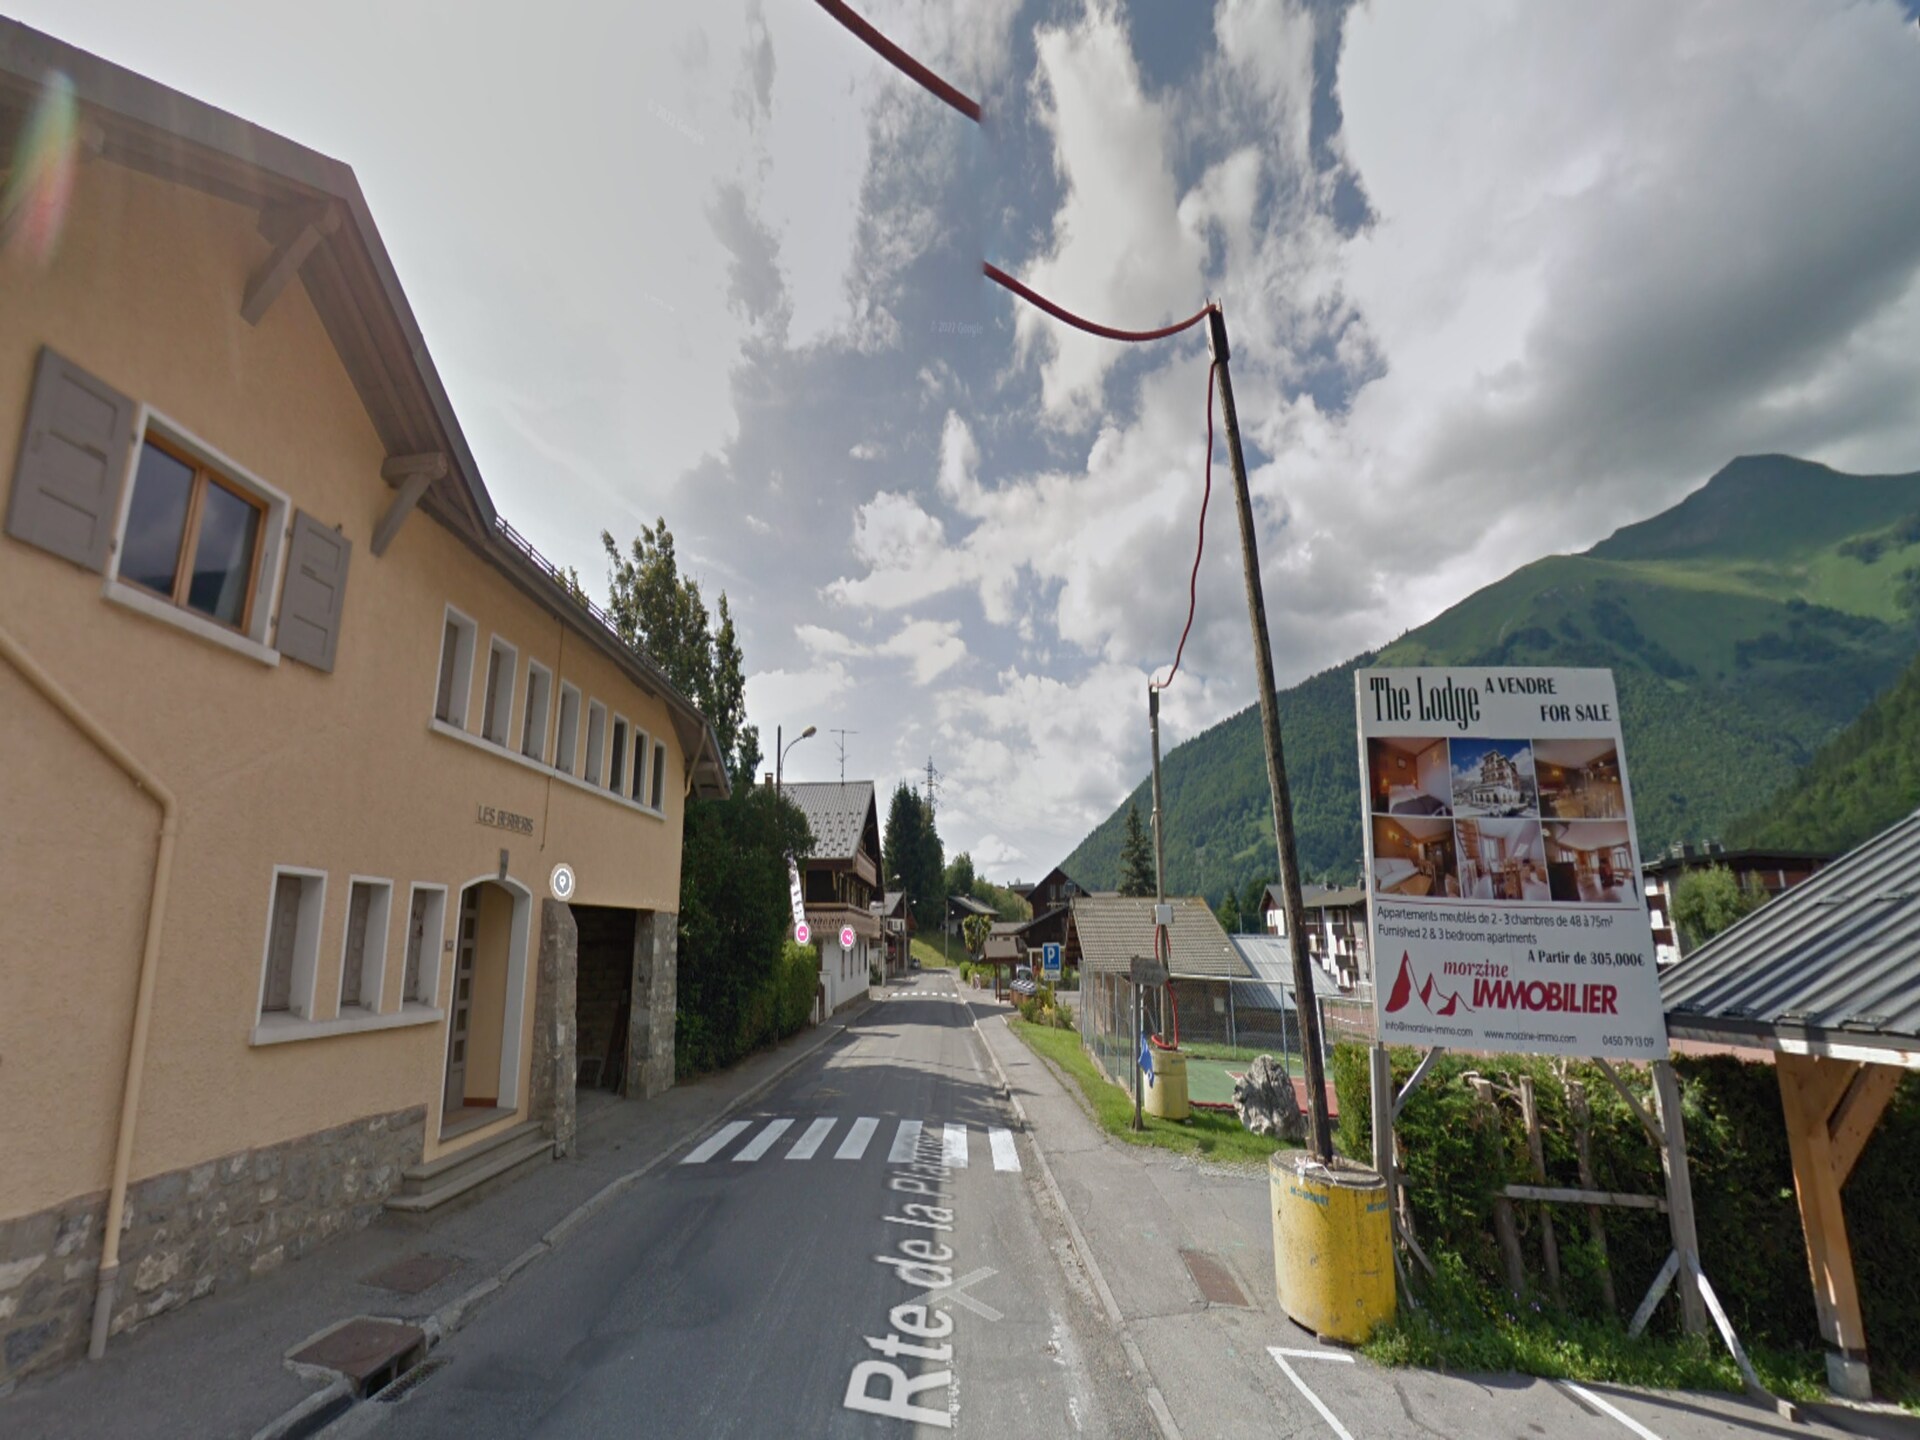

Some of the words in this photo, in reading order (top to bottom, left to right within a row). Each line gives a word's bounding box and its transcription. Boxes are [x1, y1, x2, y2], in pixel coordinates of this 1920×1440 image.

[1485, 677, 1494, 694] A
[1498, 677, 1558, 695] VENDRE
[1370, 677, 1411, 721] The
[1416, 676, 1480, 731] Lodge
[1540, 704, 1571, 722] FOR
[1575, 704, 1611, 722] SALE
[478, 804, 496, 824] LES
[1377, 906, 1438, 922] Appartements
[1440, 909, 1476, 924] meublés
[1478, 912, 1489, 924] de
[1491, 913, 1497, 925] 2
[1504, 913, 1510, 925] 3
[1511, 912, 1555, 927] chambres
[1556, 915, 1568, 927] de
[1570, 915, 1582, 927] 48
[1378, 924, 1420, 938] Furnished
[1422, 927, 1428, 939] 2
[1429, 928, 1437, 940] &
[1439, 928, 1444, 940] 3
[1445, 928, 1485, 942] bedroom
[1487, 931, 1537, 945] apartments
[1047, 947, 1055, 963] P
[1528, 950, 1535, 963] A
[1538, 950, 1570, 964] Partir
[1574, 951, 1587, 965] de
[1590, 951, 1645, 967] 305,000€
[1443, 959, 1509, 978] morzine
[1472, 978, 1618, 1015] IMMOBILIER
[1385, 1021, 1474, 1037] info@morzine-immo.com
[1484, 1029, 1577, 1044] www.morzine-immo.com
